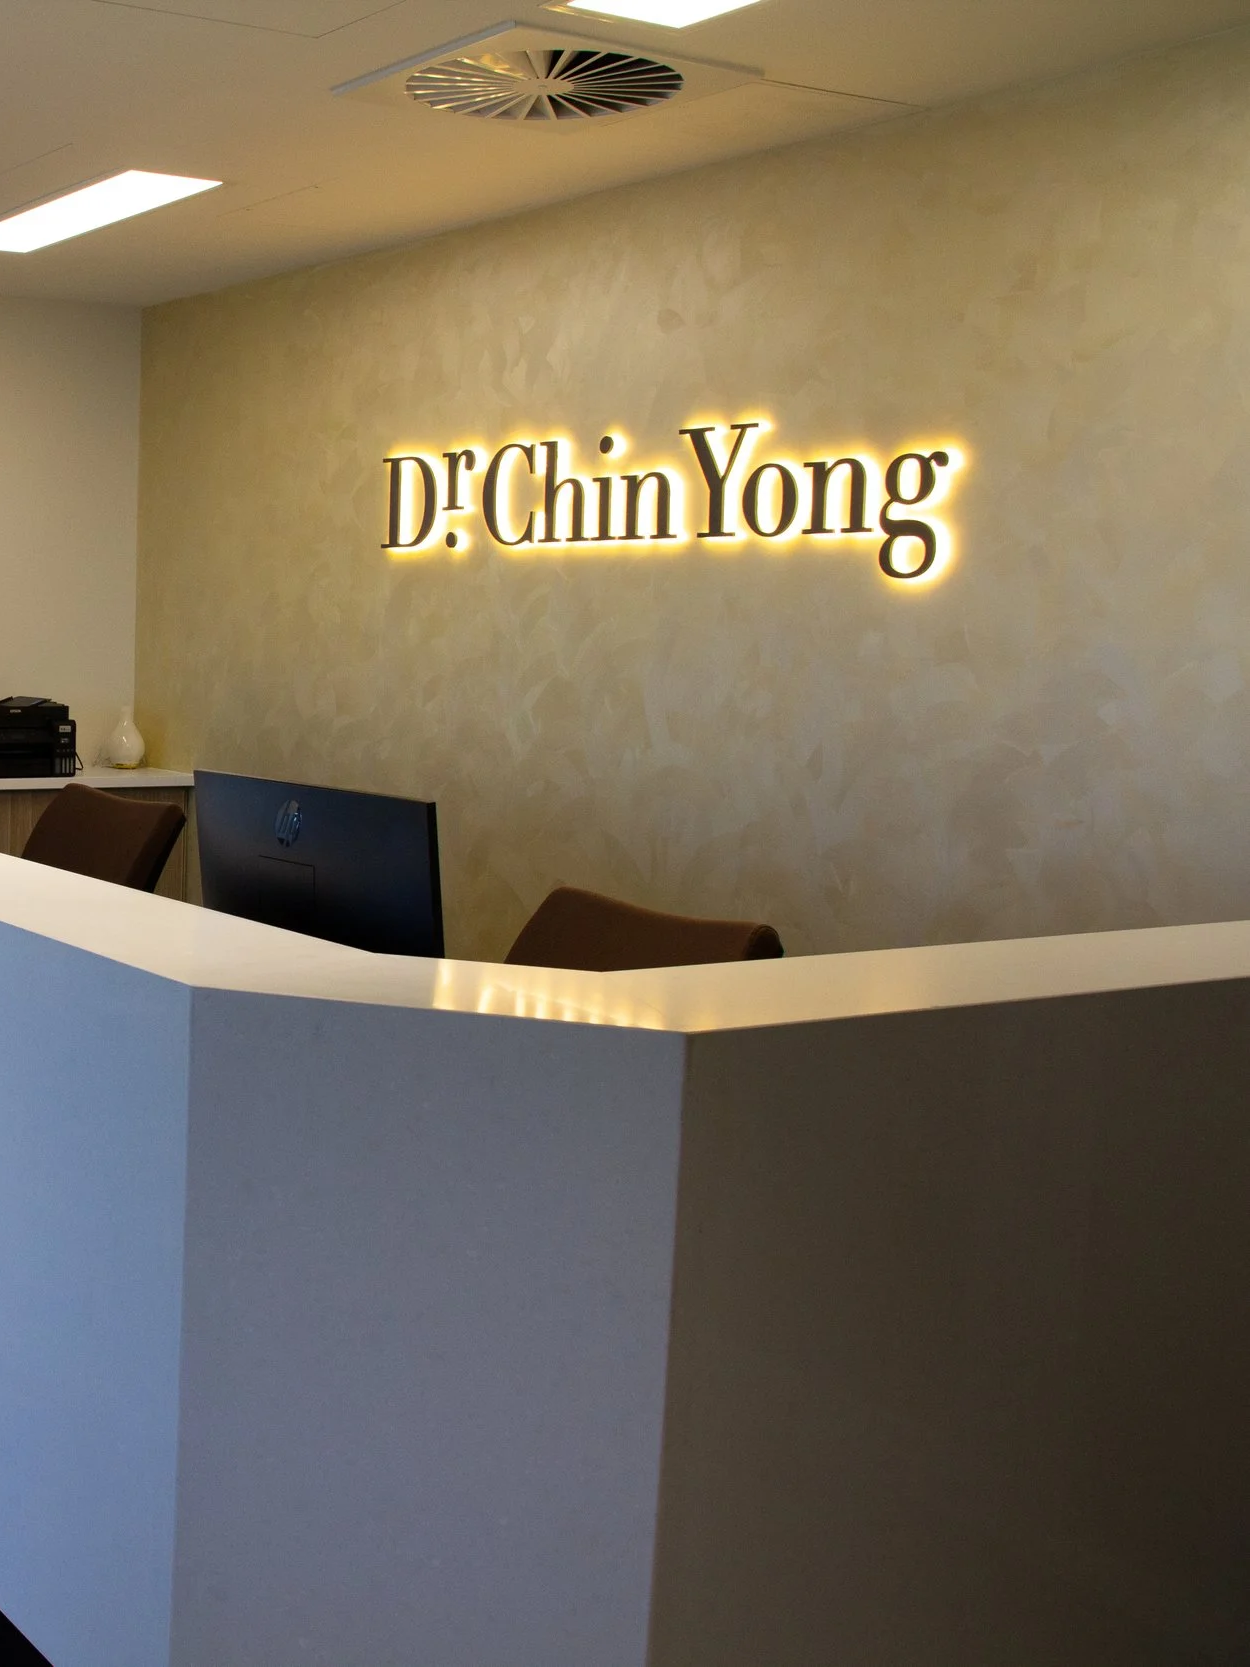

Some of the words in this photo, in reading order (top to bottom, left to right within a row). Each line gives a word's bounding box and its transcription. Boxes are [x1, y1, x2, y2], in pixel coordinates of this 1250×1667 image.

[381, 449, 475, 548] Dr.
[482, 435, 677, 547] Chin
[679, 423, 949, 579] Yong
